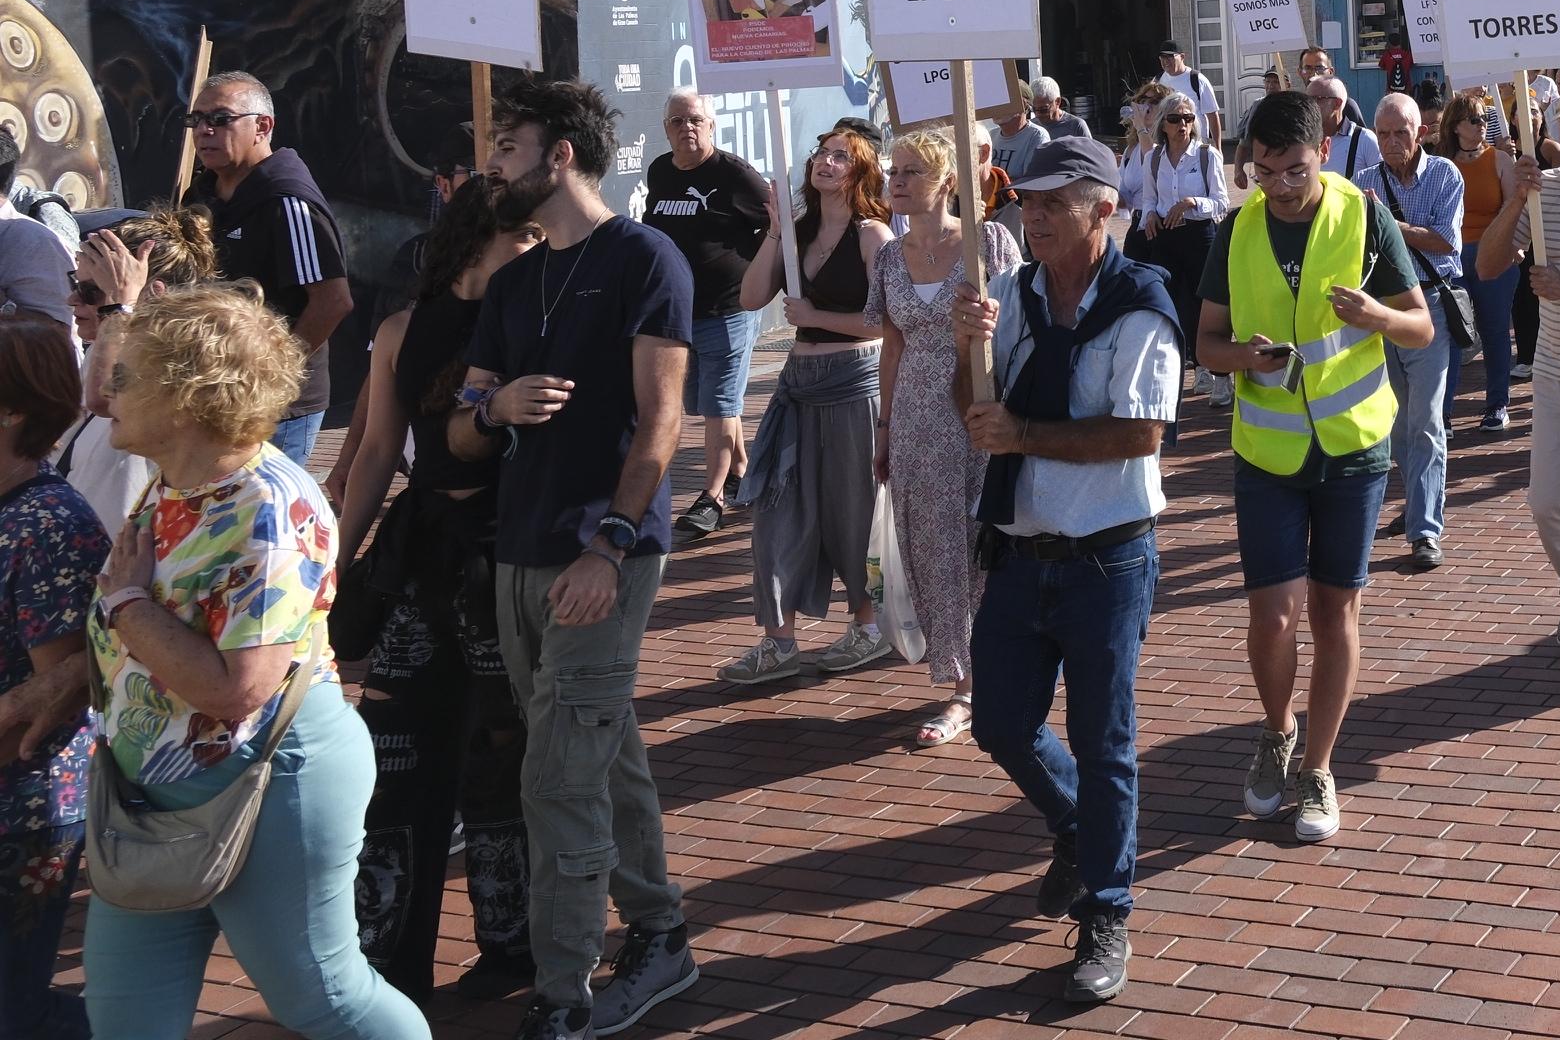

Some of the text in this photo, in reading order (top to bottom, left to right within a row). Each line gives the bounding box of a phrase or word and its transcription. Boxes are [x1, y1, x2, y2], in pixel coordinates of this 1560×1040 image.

[1233, 0, 1267, 12] SOMOS
[1249, 18, 1279, 32] LPGC
[1469, 14, 1558, 39] TORRES
[1419, 33, 1439, 43] TOR
[924, 68, 949, 83] LPG
[653, 200, 699, 216] PUMA
